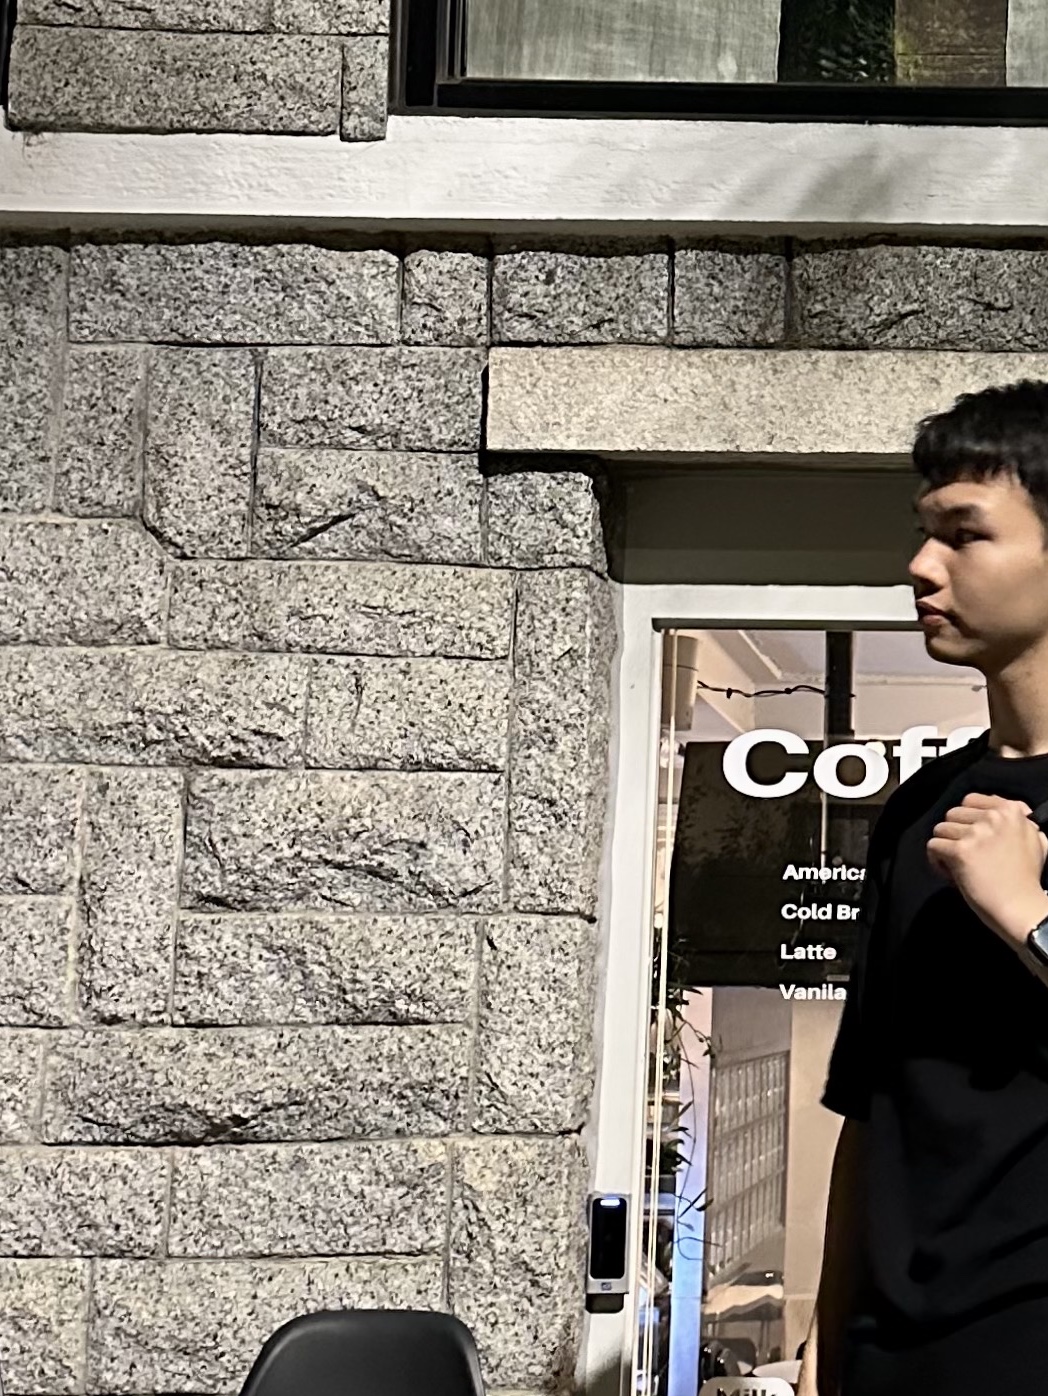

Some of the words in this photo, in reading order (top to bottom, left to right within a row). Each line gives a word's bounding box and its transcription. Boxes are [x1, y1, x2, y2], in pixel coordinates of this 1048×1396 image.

[781, 903, 833, 920] Cold
[780, 944, 837, 960] Latte
[779, 984, 847, 1000] Vanila
